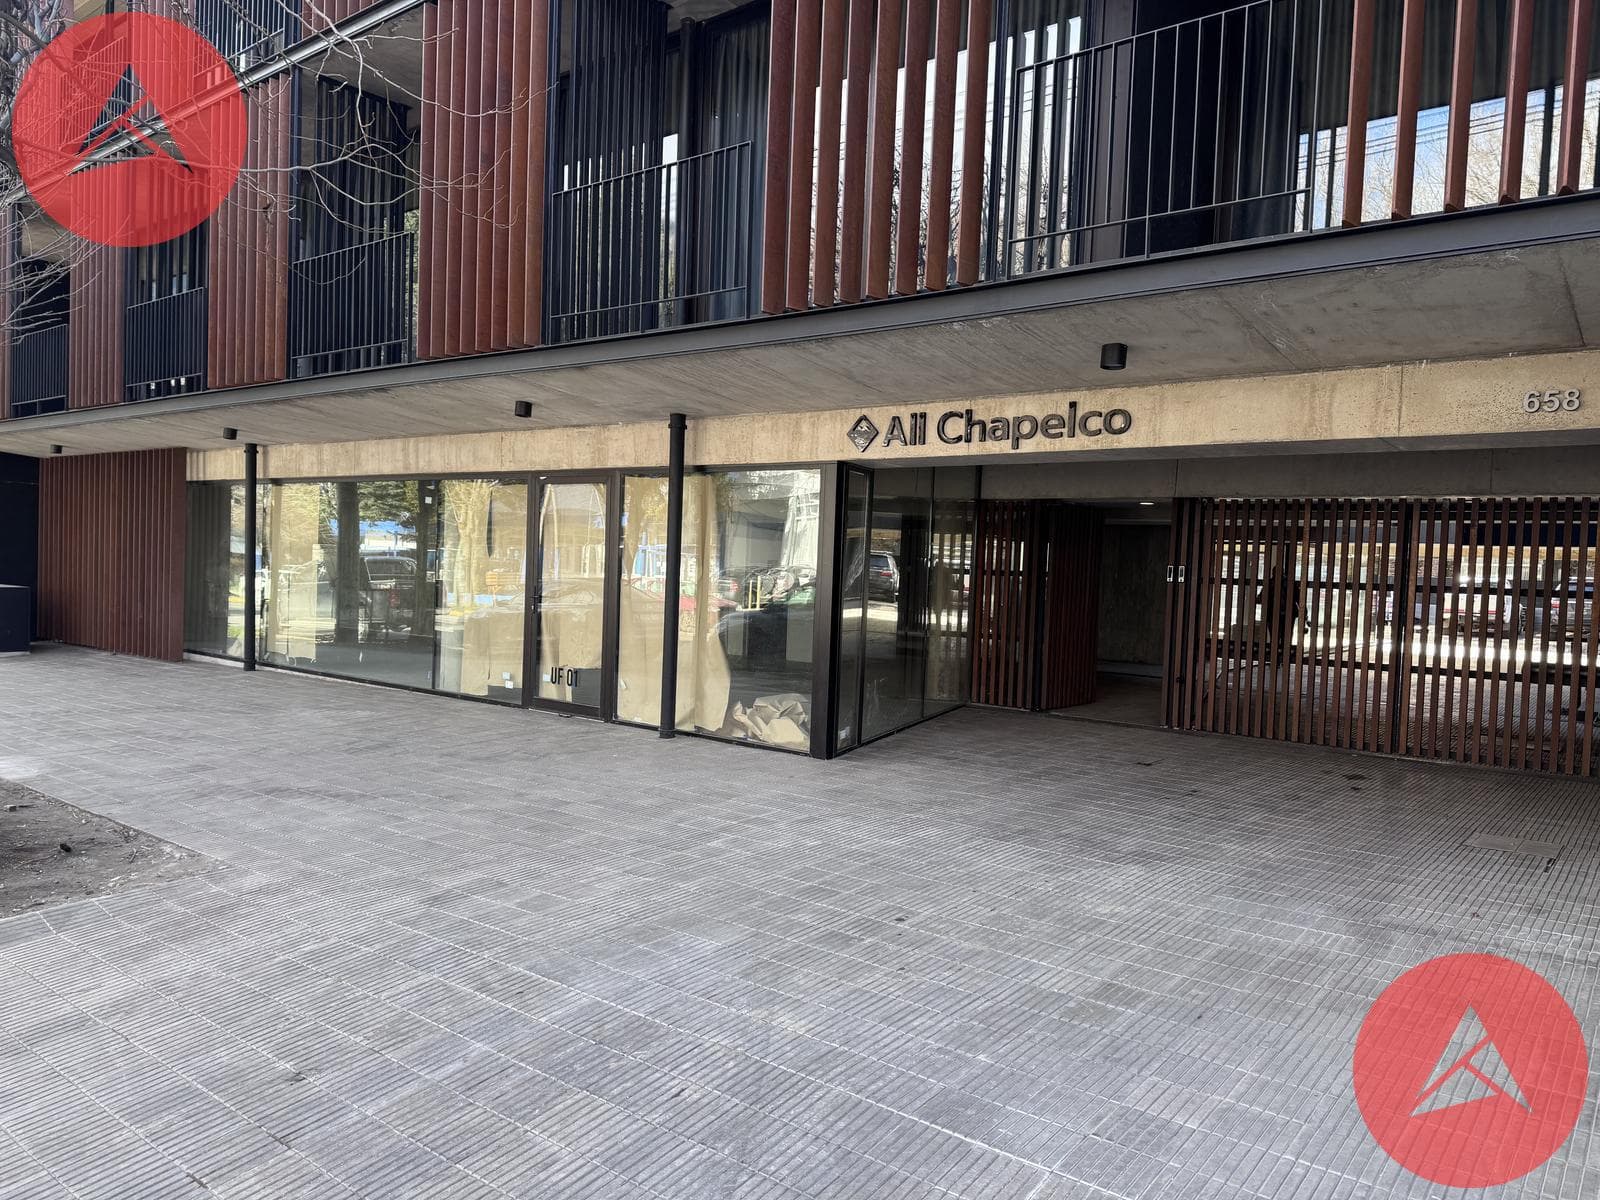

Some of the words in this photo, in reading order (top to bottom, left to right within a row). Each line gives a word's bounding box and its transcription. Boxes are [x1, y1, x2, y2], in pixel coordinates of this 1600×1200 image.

[1524, 389, 1581, 413] 658
[882, 412, 927, 447] All
[936, 401, 1132, 450] Chapelco
[551, 667, 564, 685] UF
[567, 669, 578, 687] 01
